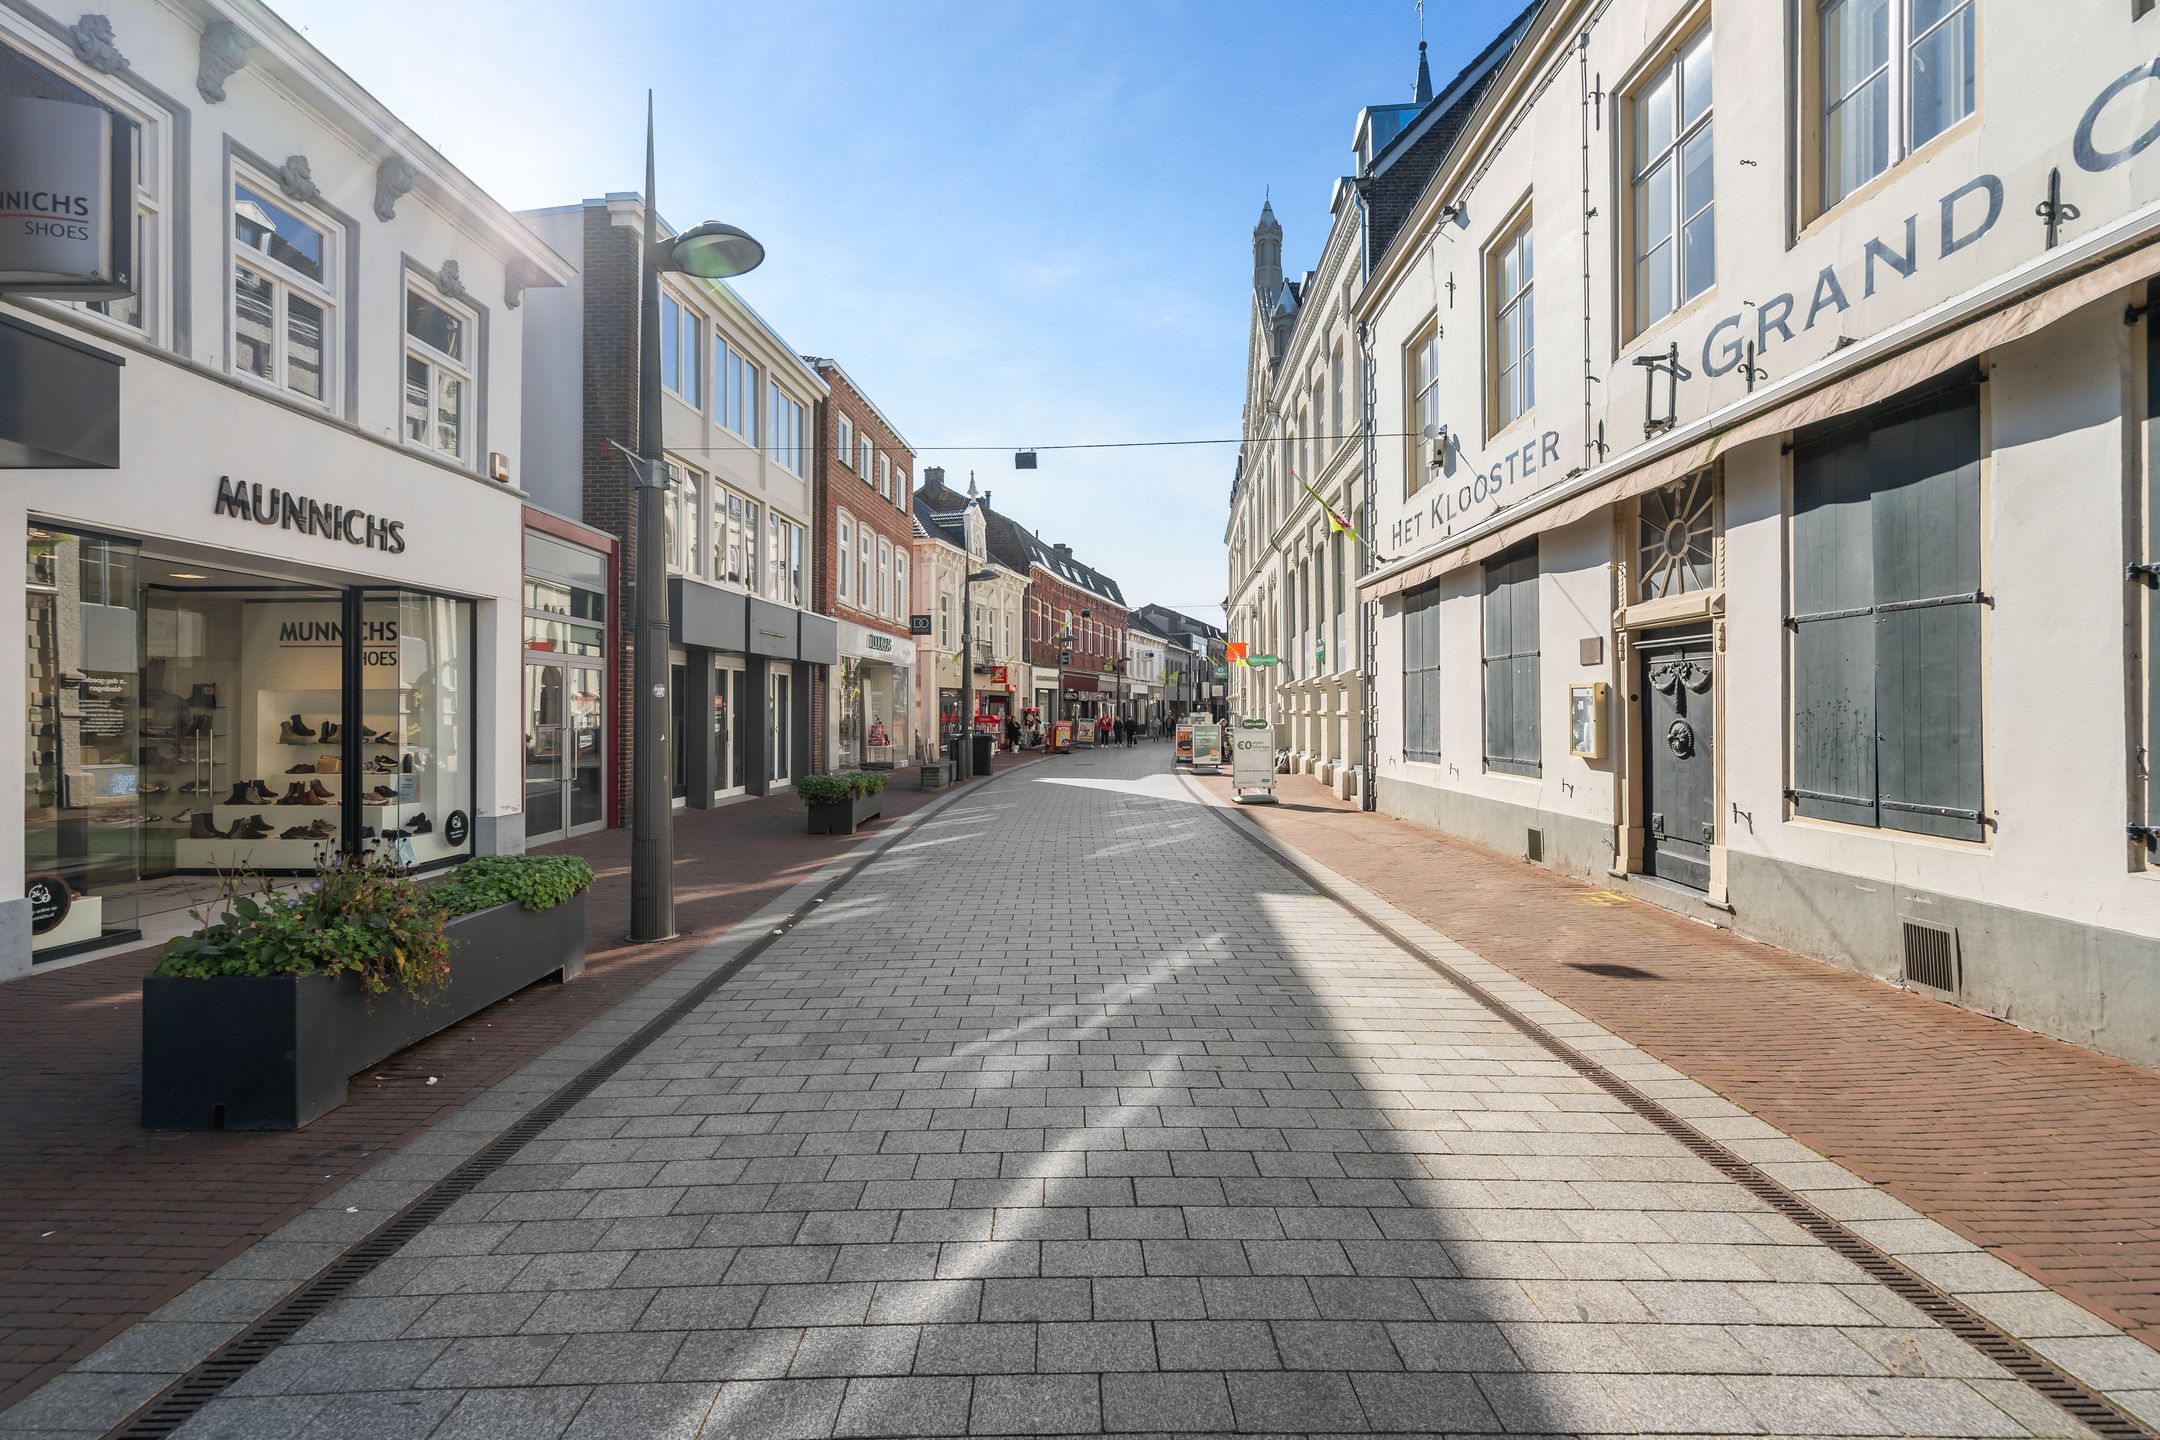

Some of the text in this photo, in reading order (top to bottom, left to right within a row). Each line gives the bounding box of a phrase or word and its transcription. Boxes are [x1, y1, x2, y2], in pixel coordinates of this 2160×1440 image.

[25, 221, 88, 240] SHOES
[1702, 174, 2004, 377] GRAND
[215, 476, 406, 554] MUNNICHS
[1393, 431, 1560, 550] HET KLOOSTER
[280, 621, 397, 641] MUNNHS
[1237, 741, 1252, 750] €0
